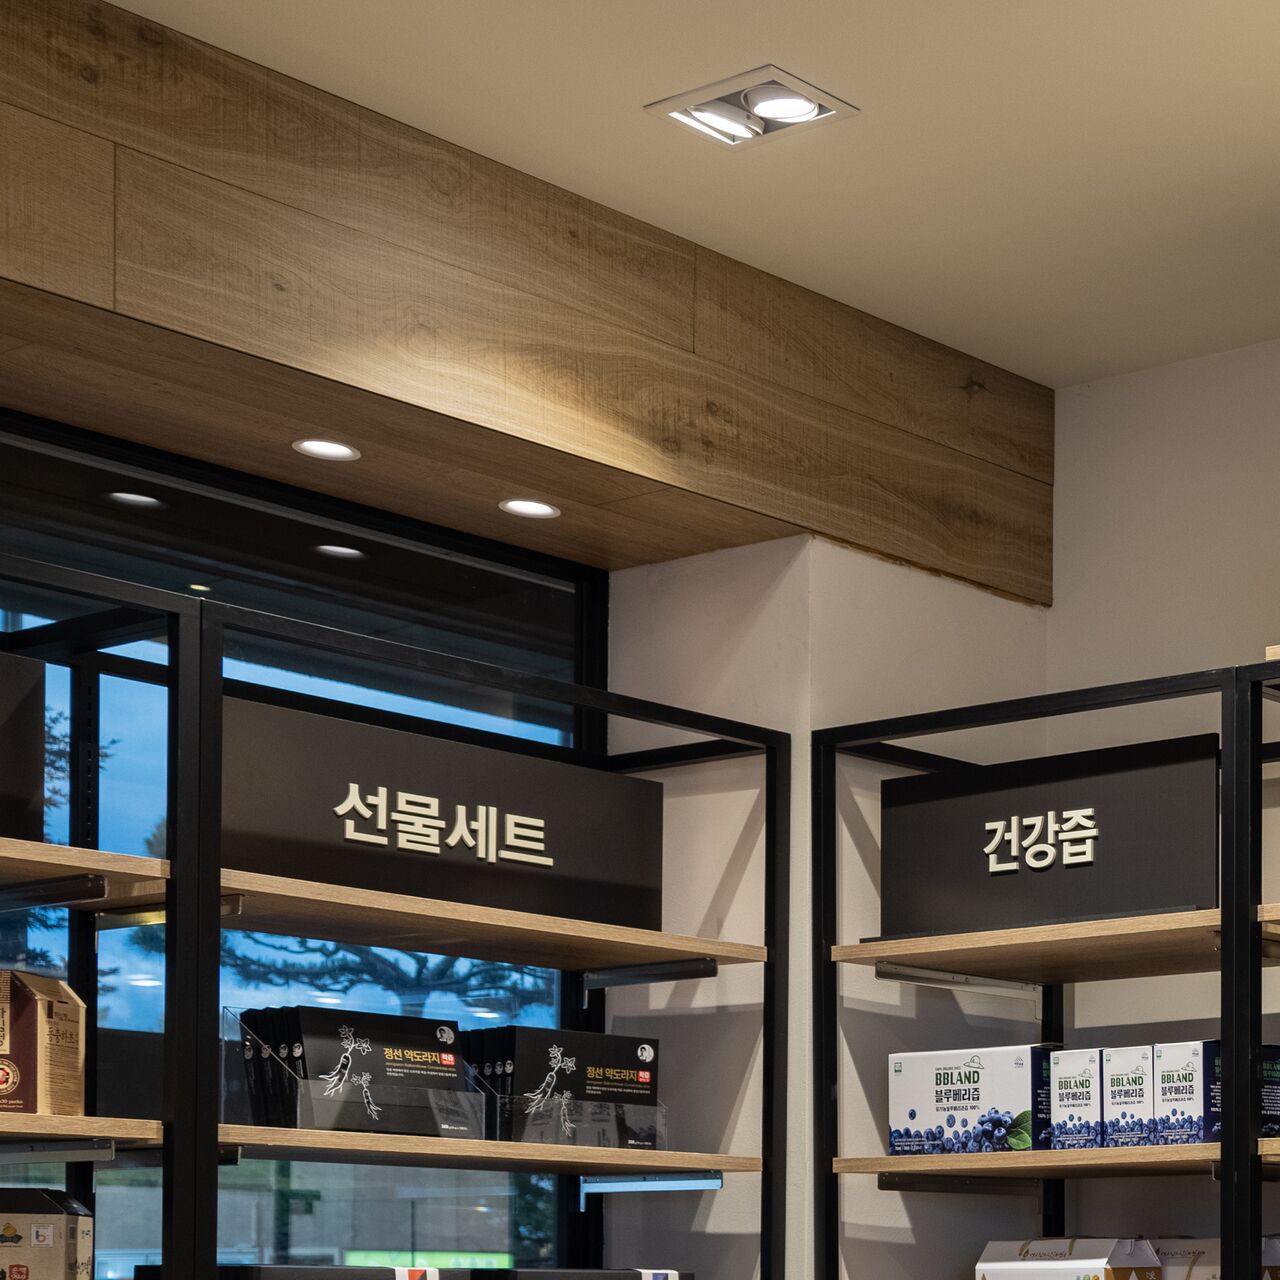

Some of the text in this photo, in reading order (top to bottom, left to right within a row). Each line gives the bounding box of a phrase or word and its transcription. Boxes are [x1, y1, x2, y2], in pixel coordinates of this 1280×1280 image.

[334, 782, 554, 867] 선물세트
[983, 808, 1099, 872] 건강즙
[383, 1048, 440, 1064] 정선 약도라지
[605, 1068, 637, 1082] 약도라지
[935, 1071, 980, 1086] BBLAND
[1161, 1072, 1193, 1084] BBLAND
[1058, 1078, 1091, 1090] BBLAND
[1110, 1076, 1144, 1088] BBLAND
[935, 1088, 980, 1103] 블루베리즙
[1058, 1091, 1091, 1102] 블루베리즙
[1110, 1088, 1144, 1100] 블루베리즙
[1161, 1085, 1194, 1097] 블루베리즙
